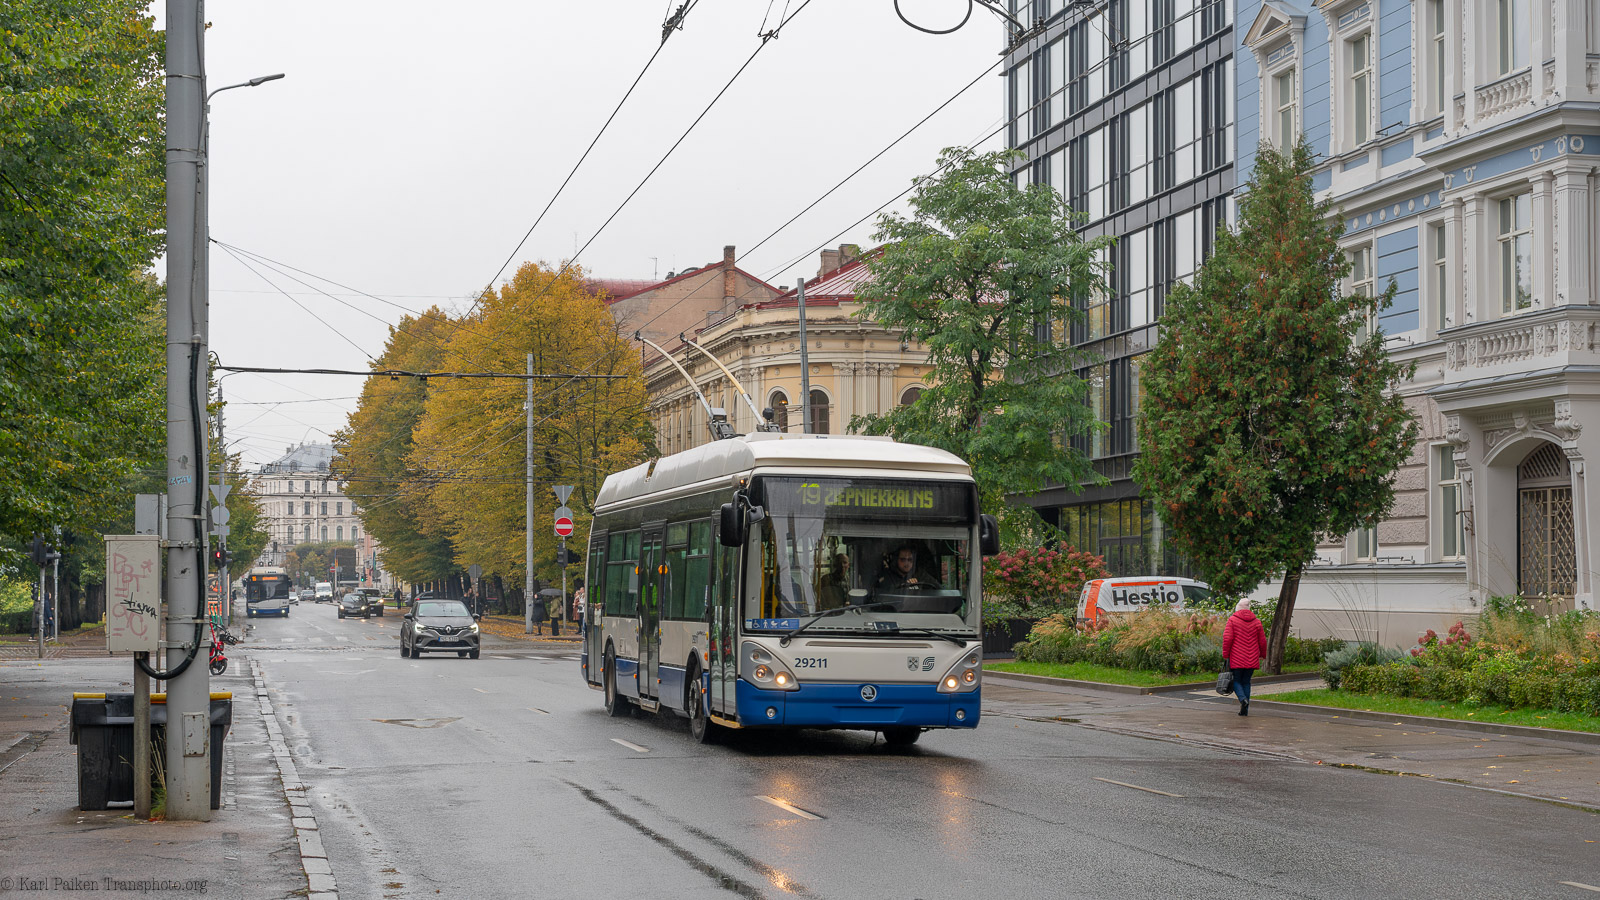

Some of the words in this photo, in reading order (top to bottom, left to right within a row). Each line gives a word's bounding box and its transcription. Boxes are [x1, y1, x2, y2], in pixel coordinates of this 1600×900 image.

[796, 483, 821, 505] 19
[824, 487, 934, 509] ZIEPNIEKKALNS
[1112, 585, 1179, 606] Hestio
[794, 657, 828, 669] 29211
